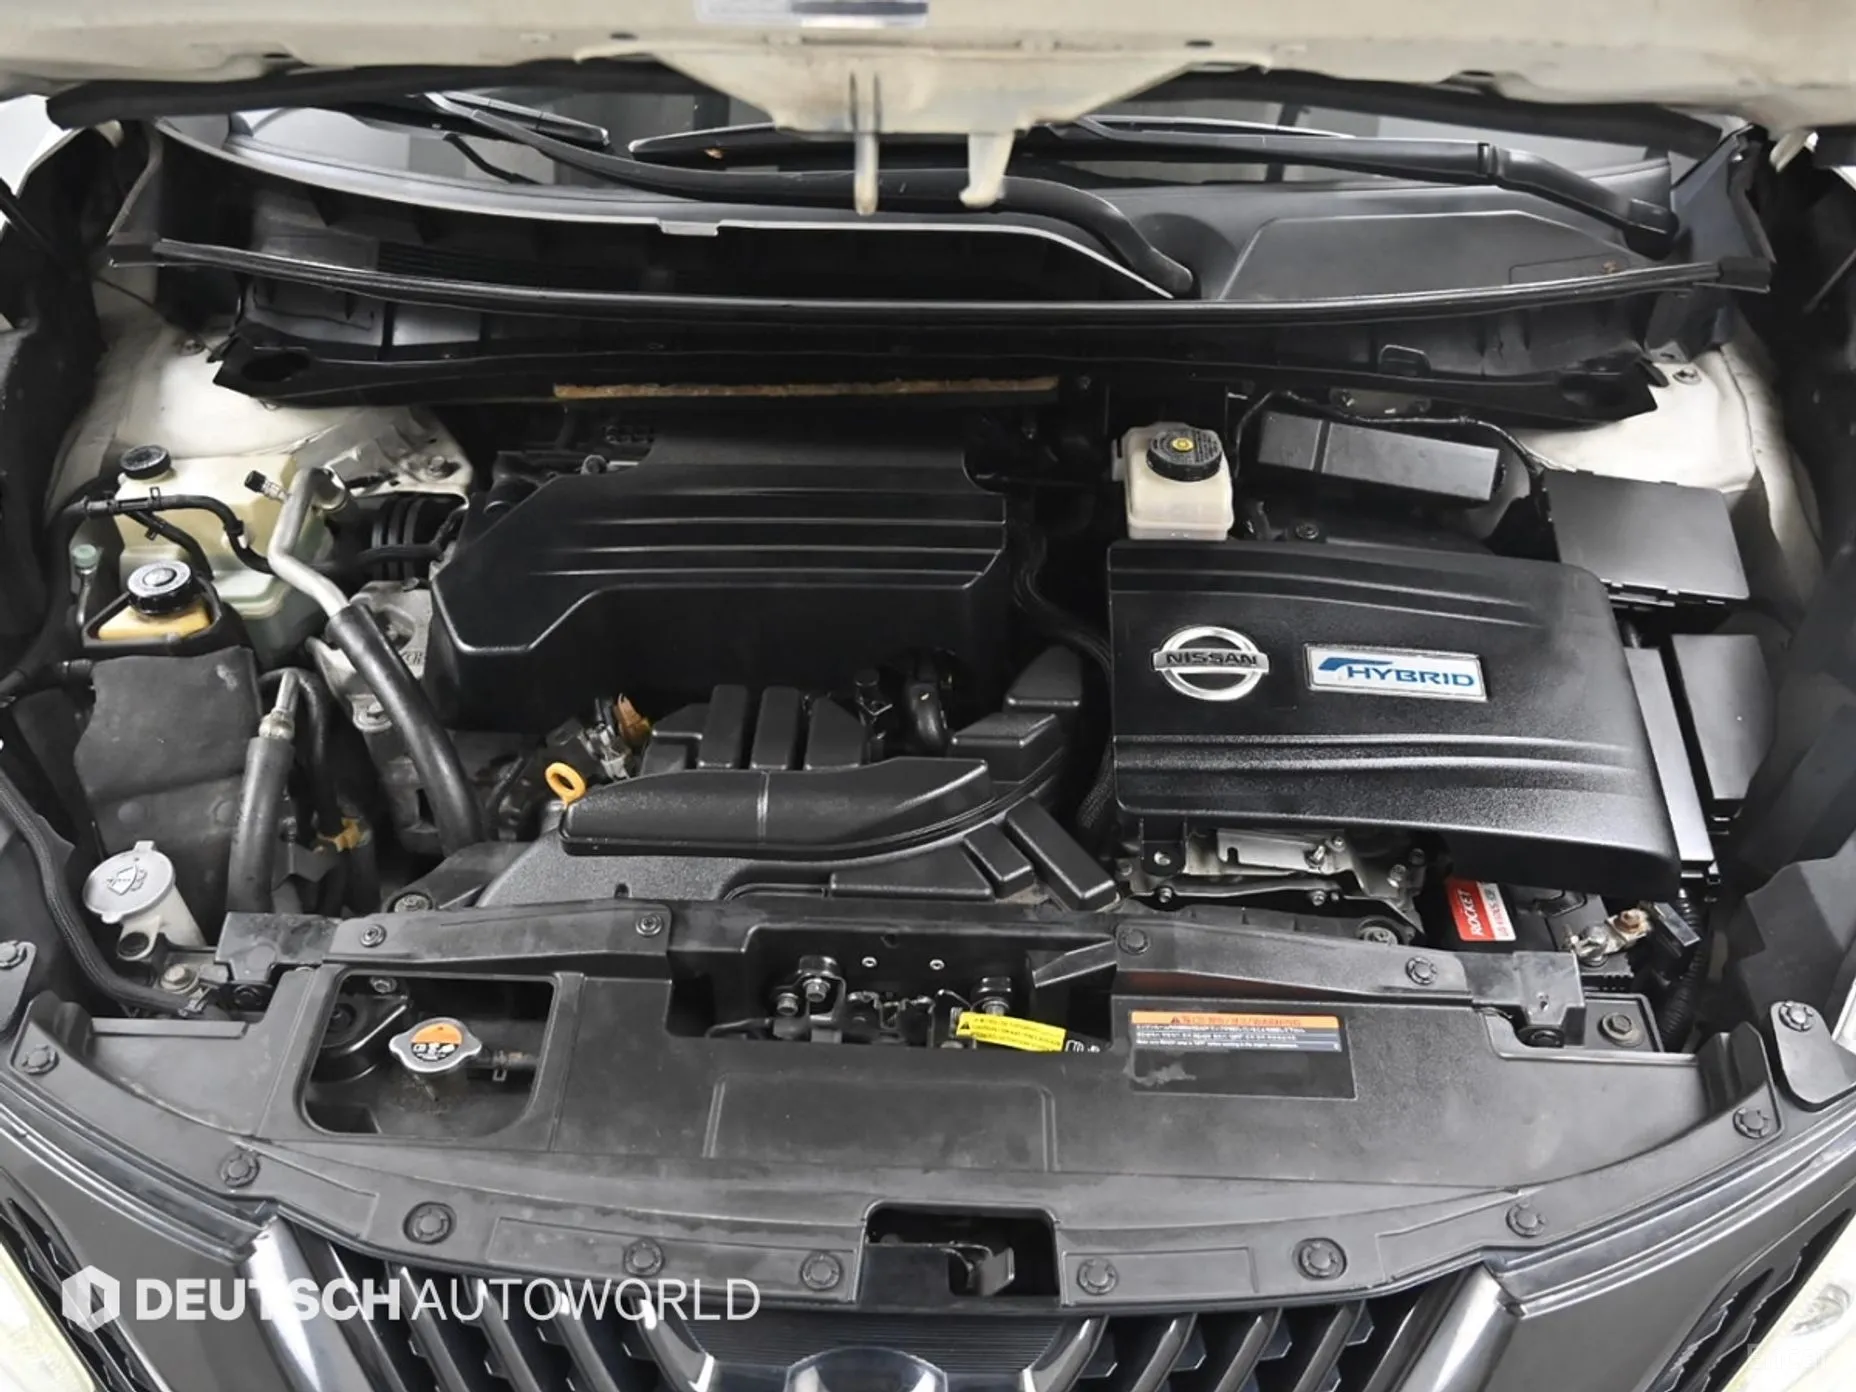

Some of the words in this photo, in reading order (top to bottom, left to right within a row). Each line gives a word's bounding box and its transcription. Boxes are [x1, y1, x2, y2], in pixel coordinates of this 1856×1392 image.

[1165, 652, 1258, 666] NISSAN
[1348, 665, 1475, 688] HYBRID
[1457, 888, 1485, 938] ROCKET
